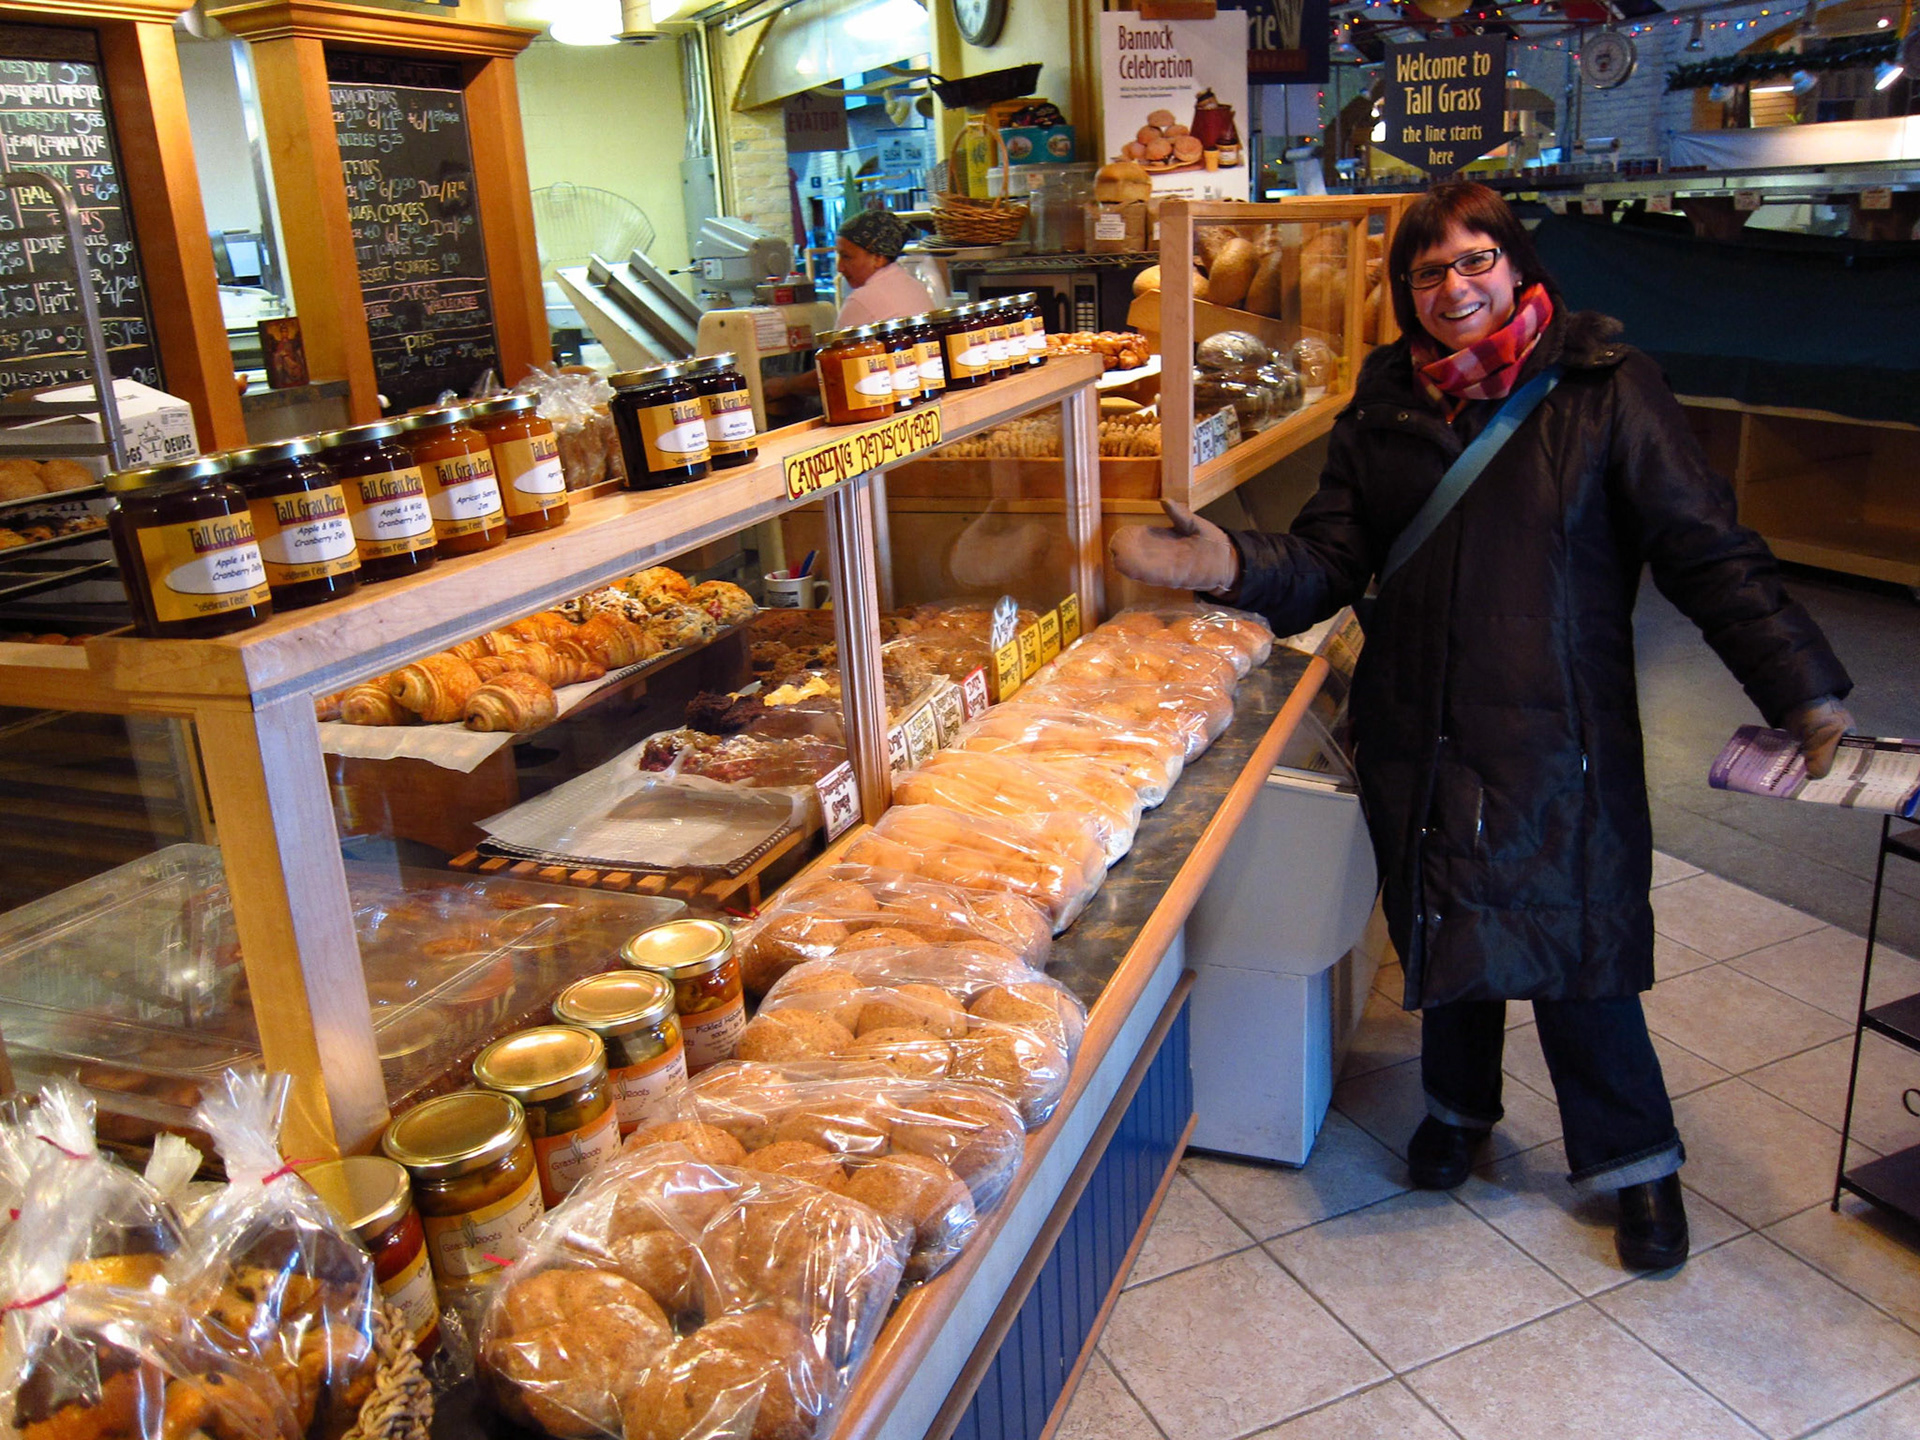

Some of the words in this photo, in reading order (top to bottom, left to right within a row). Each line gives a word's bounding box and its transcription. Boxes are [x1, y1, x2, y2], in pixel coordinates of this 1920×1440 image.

[1118, 25, 1174, 51] Bannock
[1118, 54, 1194, 80] Celebration
[1396, 52, 1467, 83] Welcome
[1472, 50, 1492, 77] to
[1404, 84, 1433, 115] Tall
[1438, 83, 1482, 113] Grass
[788, 111, 840, 133] EVATOR
[1402, 126, 1421, 143] the
[1425, 125, 1446, 142] line
[1450, 125, 1482, 141] starts
[78, 134, 106, 158] RYE
[1428, 147, 1454, 165] here
[389, 284, 440, 302] CAKES
[164, 434, 193, 455] OEUFS
[788, 442, 854, 499] CANNING
[856, 410, 941, 473] REDISCOVERED
[435, 464, 454, 483] Tall
[455, 461, 478, 479] Grass
[478, 457, 490, 474] Pra
[357, 480, 378, 500] Tall
[380, 478, 405, 496] Grass
[273, 500, 296, 522] Tall
[298, 496, 325, 517] Grass
[380, 506, 402, 517] Apple
[187, 525, 211, 549] Tall
[213, 522, 239, 544] Grass
[239, 518, 255, 538] Pra
[297, 524, 320, 536] Apple
[378, 516, 413, 529] Cranberry
[294, 535, 332, 548] Cranberry
[215, 554, 238, 568] Apple
[212, 567, 251, 581] Cranberry
[551, 1157, 577, 1171] Grass
[582, 1147, 602, 1160] Roots
[442, 1240, 469, 1253] Grass
[475, 1231, 503, 1245] Roots
